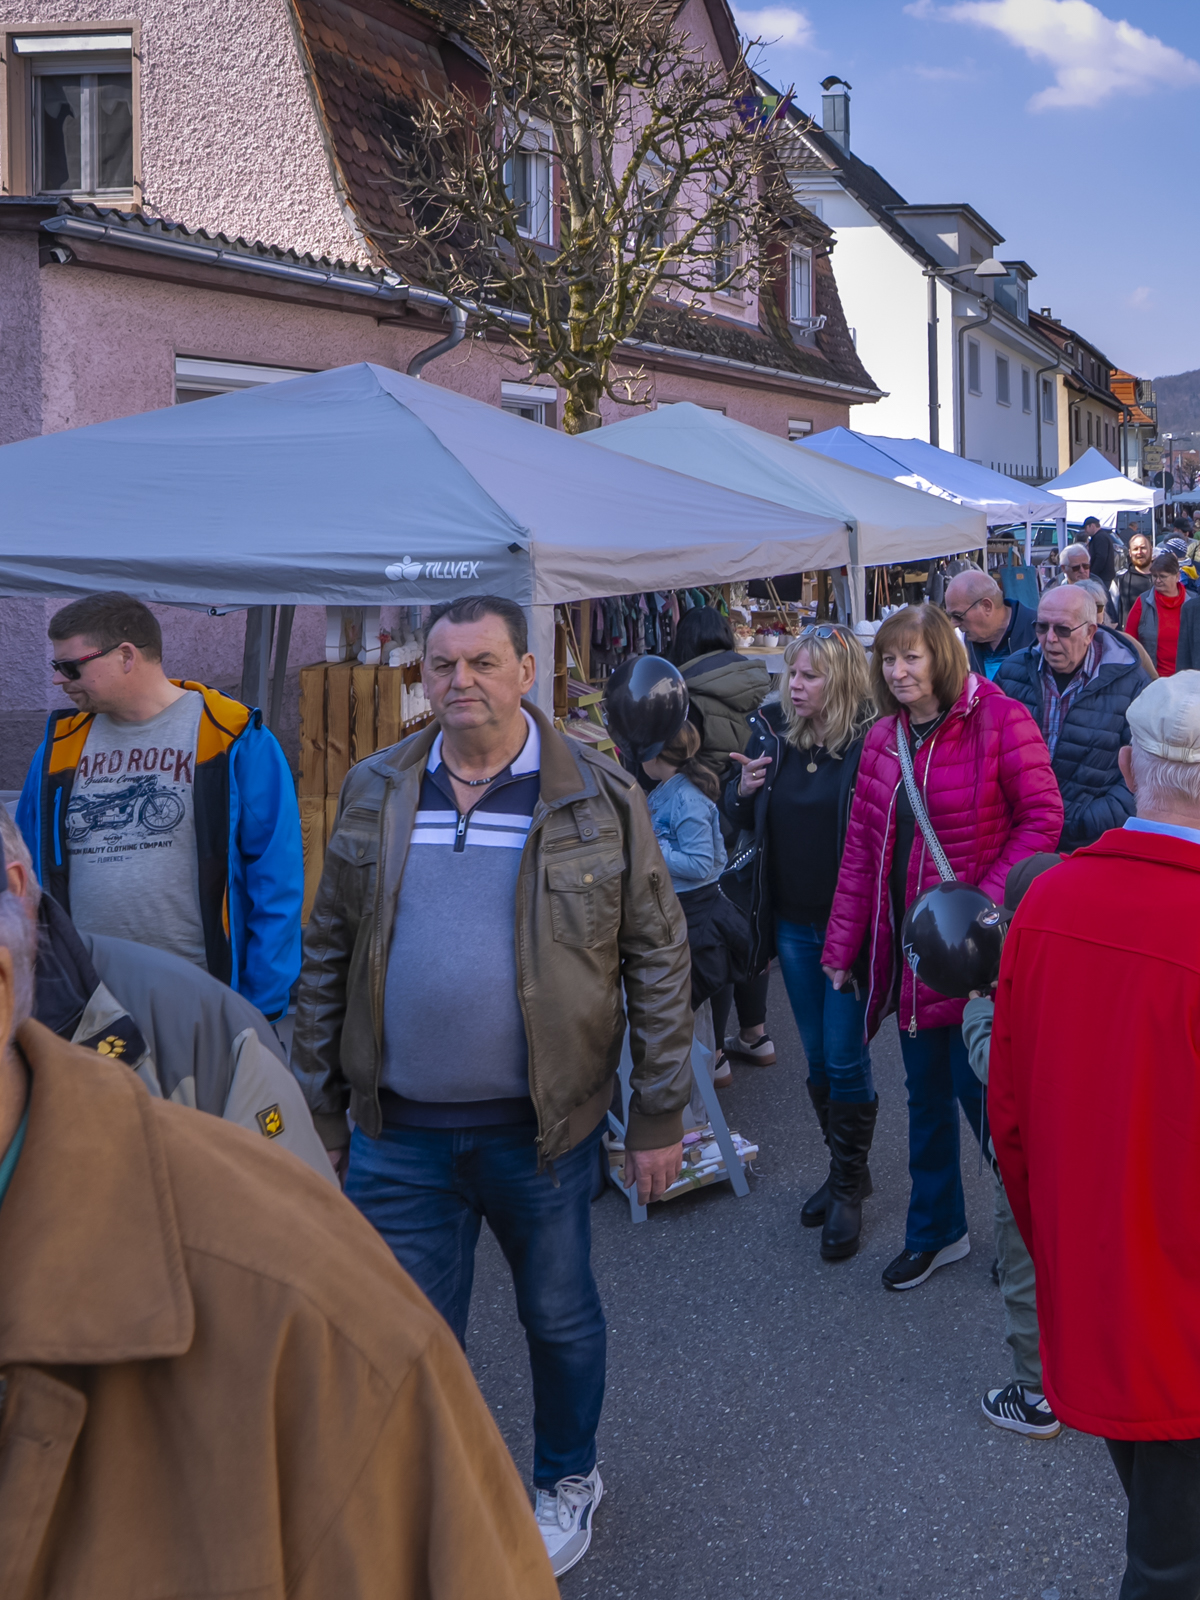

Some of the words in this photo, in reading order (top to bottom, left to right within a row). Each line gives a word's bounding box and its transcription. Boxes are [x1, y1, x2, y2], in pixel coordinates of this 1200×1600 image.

[425, 560, 480, 579] TILLVEX
[77, 749, 123, 779] ARD
[126, 747, 193, 784] ROCK
[106, 843, 138, 853] CLOTHING
[139, 840, 173, 849] COMPANY
[97, 855, 124, 864] FLORENCE
